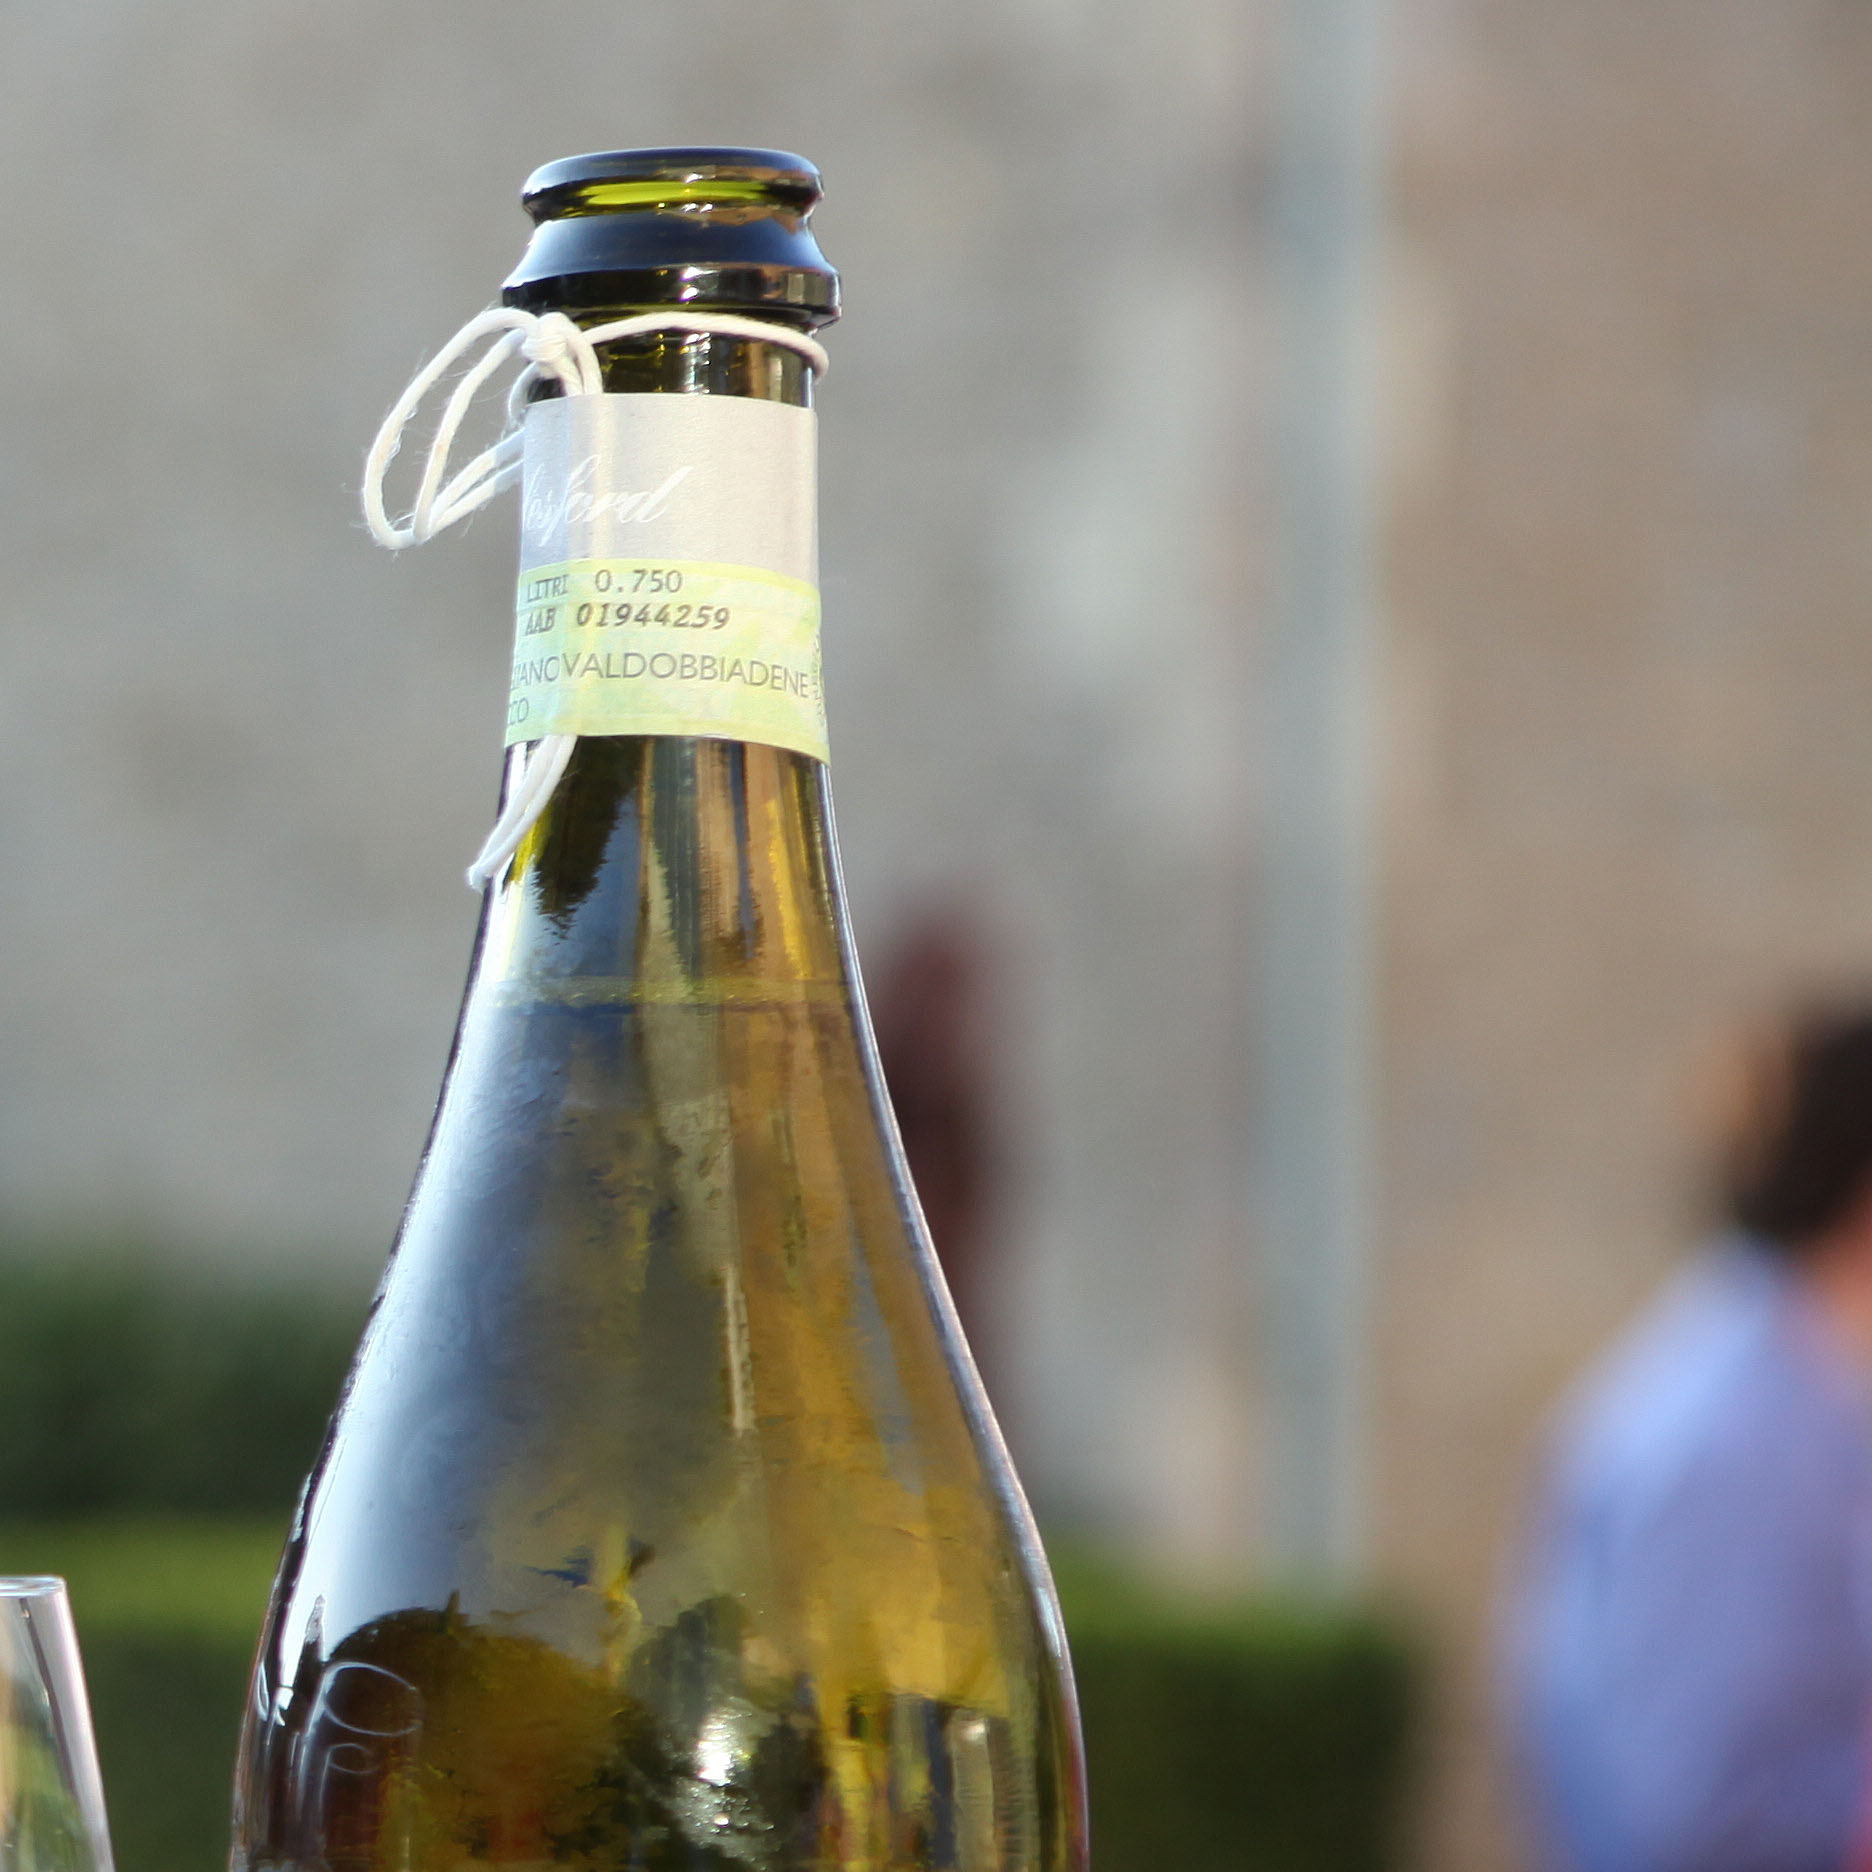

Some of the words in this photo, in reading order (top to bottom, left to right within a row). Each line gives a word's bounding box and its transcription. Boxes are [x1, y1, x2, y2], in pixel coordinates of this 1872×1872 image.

[527, 573, 569, 603] LITRI
[594, 568, 683, 594] 0.750
[525, 608, 557, 636] AAB
[575, 602, 731, 630] 01944259
[560, 651, 809, 699] VALDOBBIADENE
